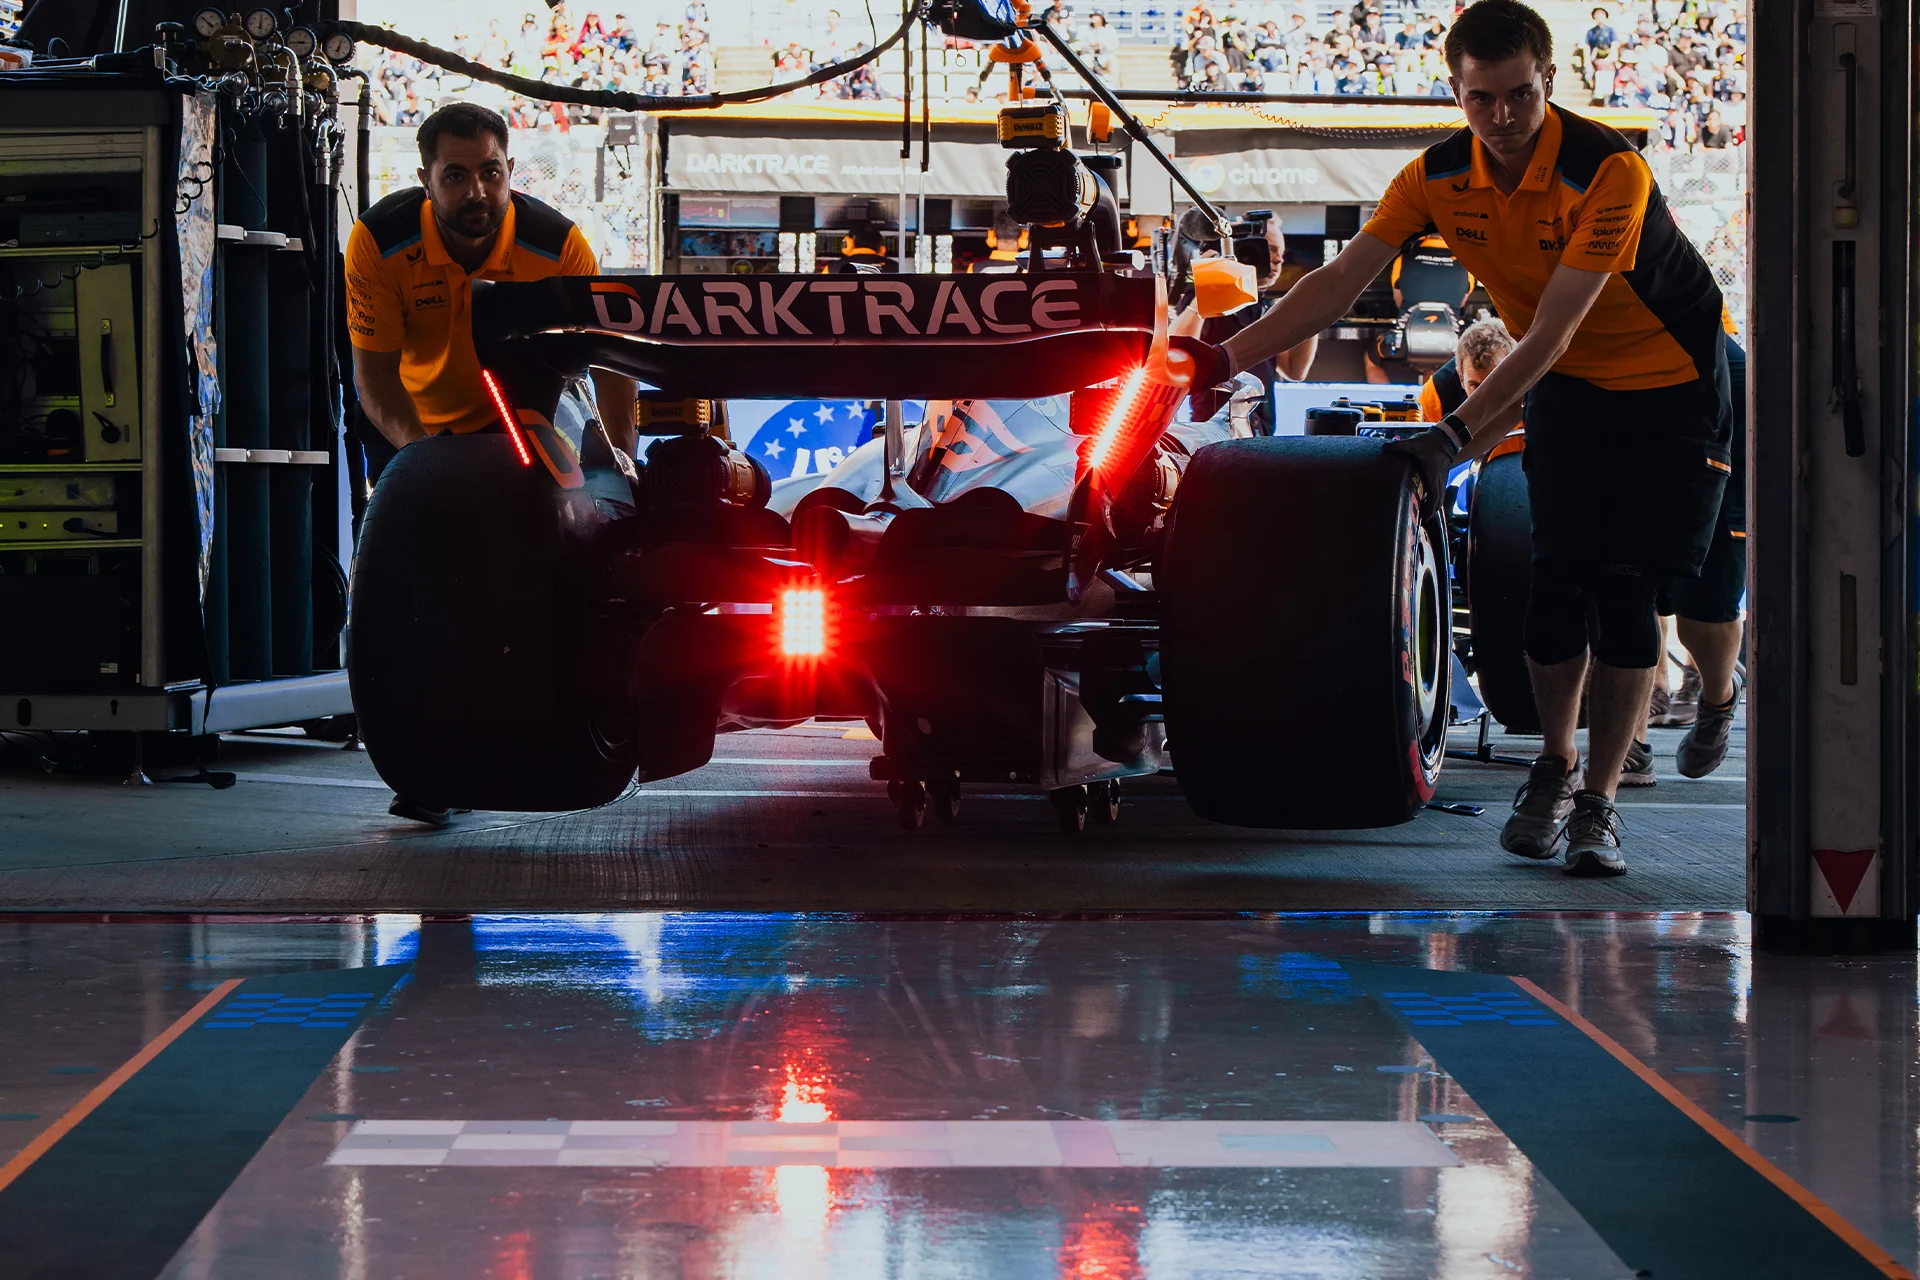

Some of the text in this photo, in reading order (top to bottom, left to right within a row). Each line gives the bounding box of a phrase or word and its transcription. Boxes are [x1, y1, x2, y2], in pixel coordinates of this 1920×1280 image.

[687, 153, 830, 176] DARKTRACE
[1228, 162, 1319, 185] chrome
[1452, 210, 1479, 219] android
[1455, 227, 1488, 241] DELL
[415, 295, 445, 307] DELL
[590, 279, 1081, 335] DARKTRACE
